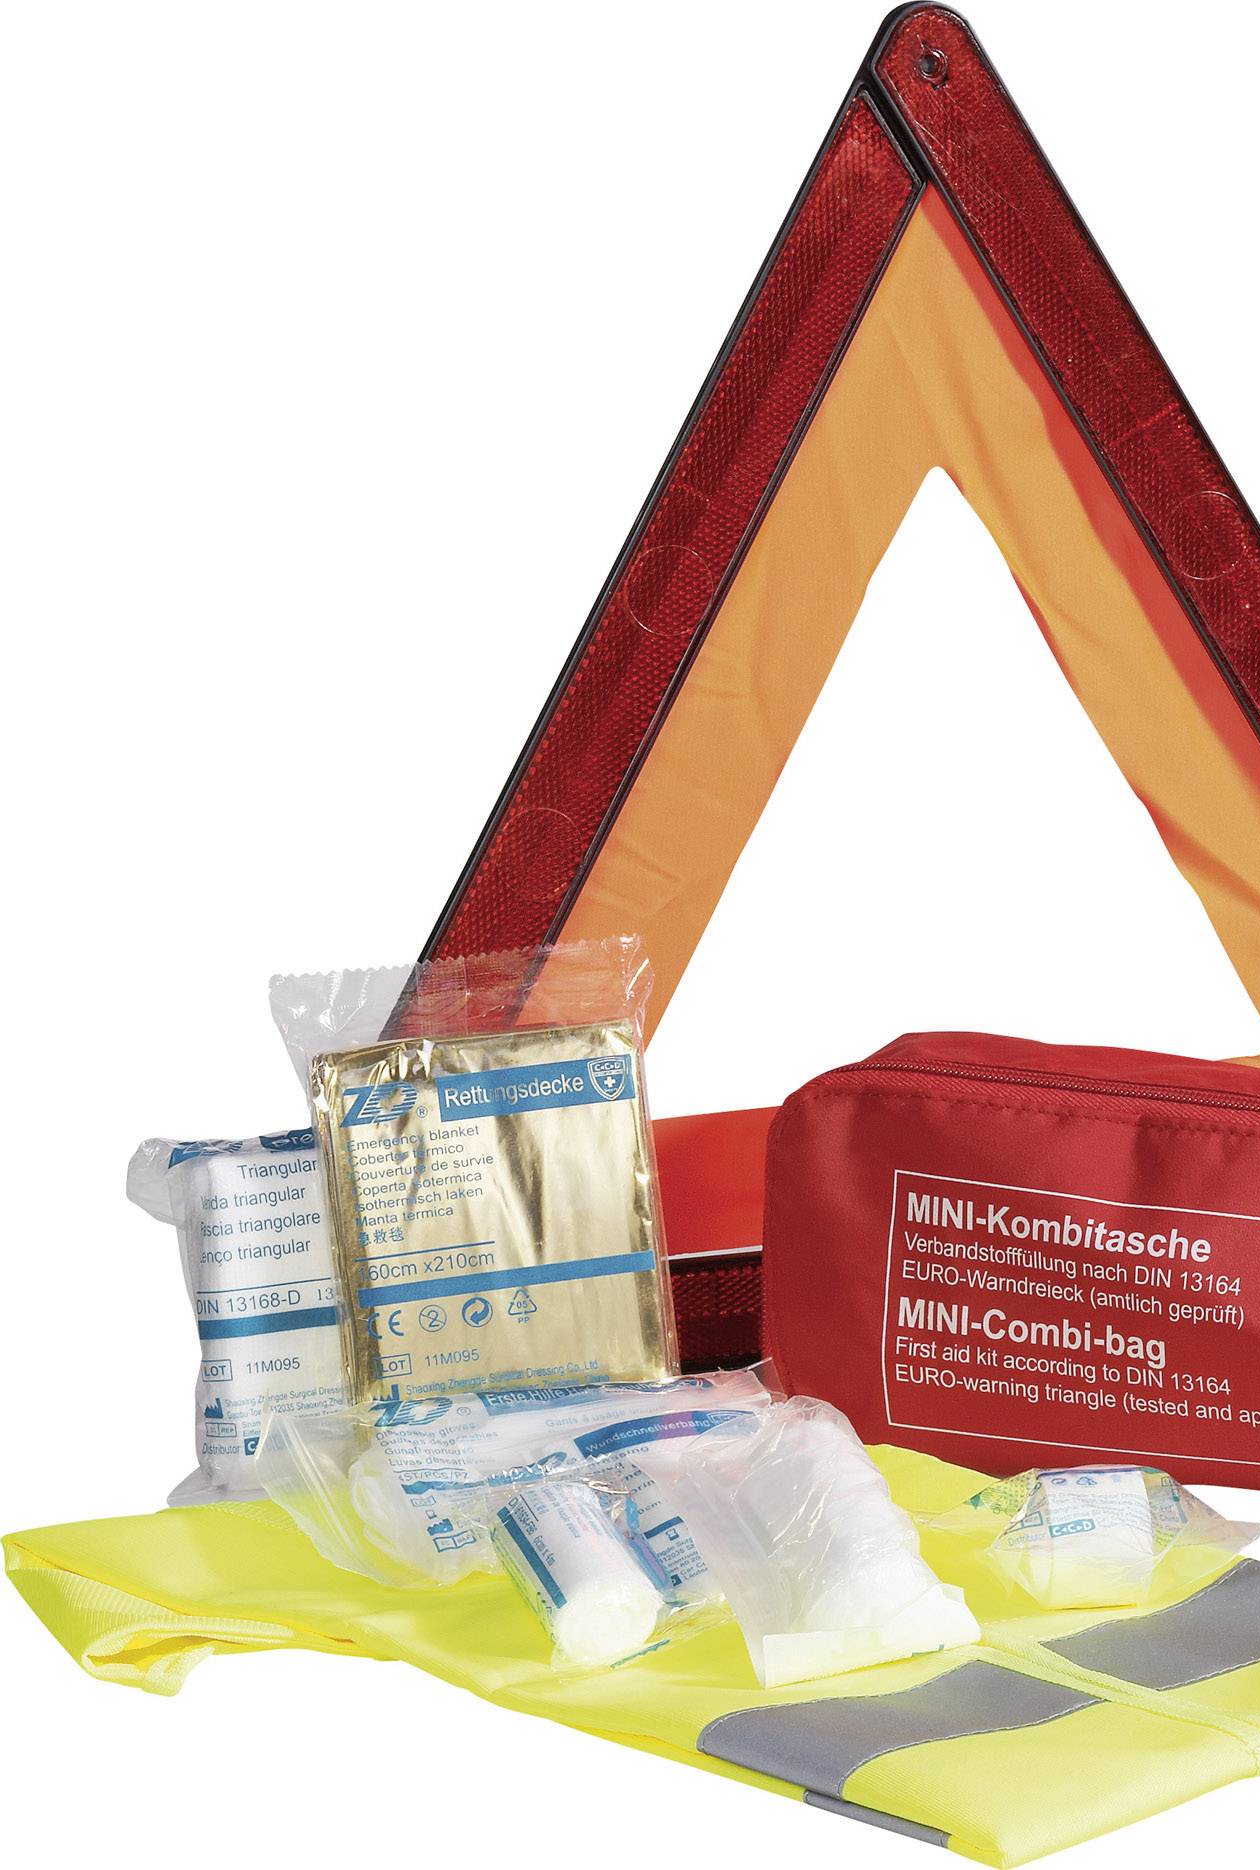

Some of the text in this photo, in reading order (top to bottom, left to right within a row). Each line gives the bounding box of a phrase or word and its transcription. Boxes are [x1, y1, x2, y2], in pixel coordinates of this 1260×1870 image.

[444, 1074, 585, 1108] Rettungsdecke
[346, 1125, 480, 1153] Emergency blanket
[236, 1158, 317, 1181] Triangular
[350, 1153, 495, 1183] Couverture de survie
[233, 1185, 306, 1208] triangular
[352, 1181, 407, 1200] Coperta
[445, 1185, 484, 1202] laken
[238, 1210, 321, 1234] triangolare
[355, 1205, 455, 1229] Manta termica
[906, 1190, 1213, 1264] MINI-Kombitasche
[237, 1238, 311, 1261] triangular
[358, 1264, 417, 1282] 160cm
[904, 1231, 1241, 1297] Verbandstofffüllung nach DIN 13164
[196, 1299, 220, 1316] DIN
[226, 1289, 301, 1314] 13168-D
[902, 1259, 1245, 1331] EURO-Warndreieck (amtlich geprüft)
[517, 1315, 531, 1325] PP
[897, 1296, 1167, 1368] MINI-Combi-bag
[203, 1356, 301, 1378] LOT 11M095
[380, 1348, 481, 1374] LOT 11M095
[895, 1336, 1231, 1397] First aid kit according to DIN 13164
[289, 1387, 319, 1400] Surgical
[895, 1364, 1039, 1404] EURO-warning
[1045, 1383, 1117, 1410] triangle
[1122, 1391, 1189, 1418] (tested
[1195, 1400, 1232, 1422] and
[202, 1442, 241, 1455] Distributor
